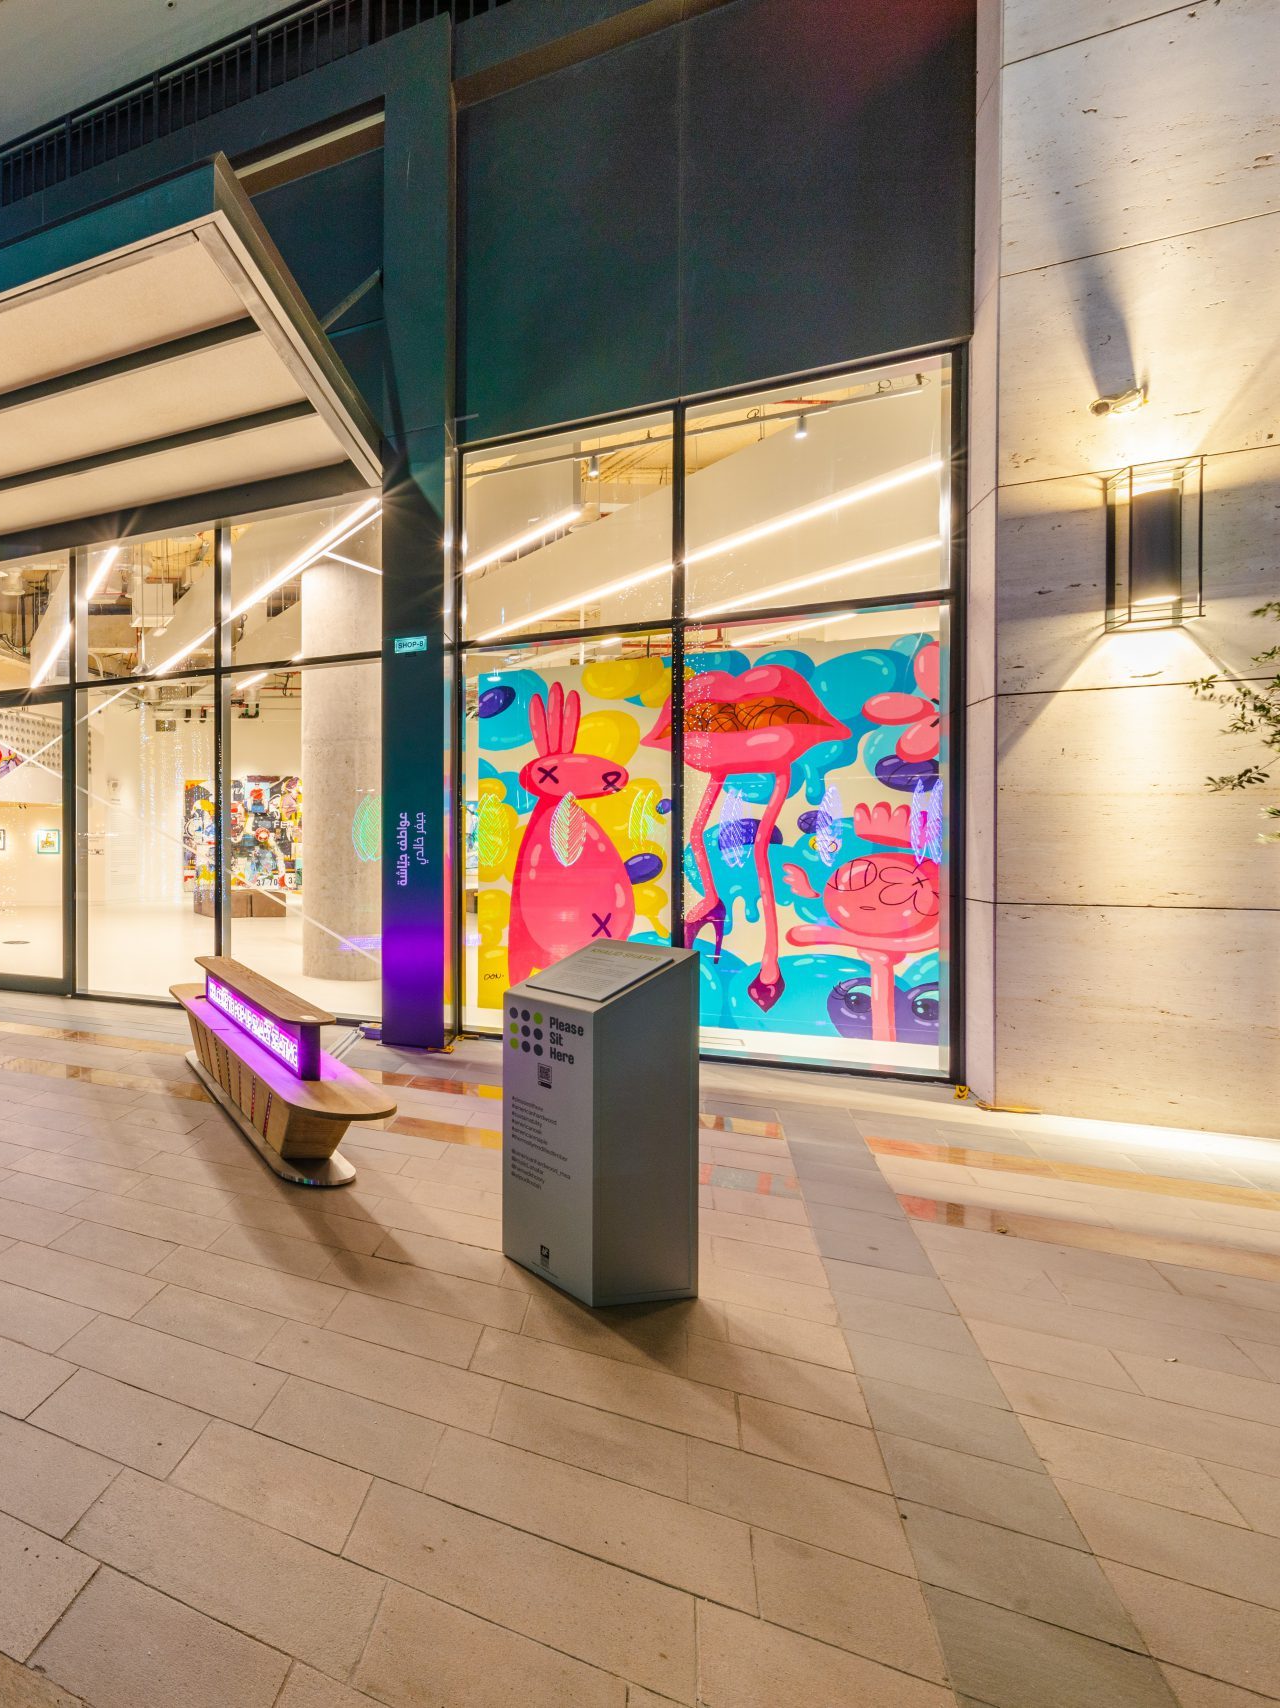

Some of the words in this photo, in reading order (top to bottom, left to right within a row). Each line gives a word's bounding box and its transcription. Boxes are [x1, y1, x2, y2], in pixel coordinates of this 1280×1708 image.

[396, 812, 410, 851] عواطف
[413, 811, 427, 835] جيفر
[412, 836, 429, 865] خالدي
[549, 1016, 584, 1037] Please
[549, 1031, 564, 1047] Sit
[549, 1046, 575, 1065] Here
